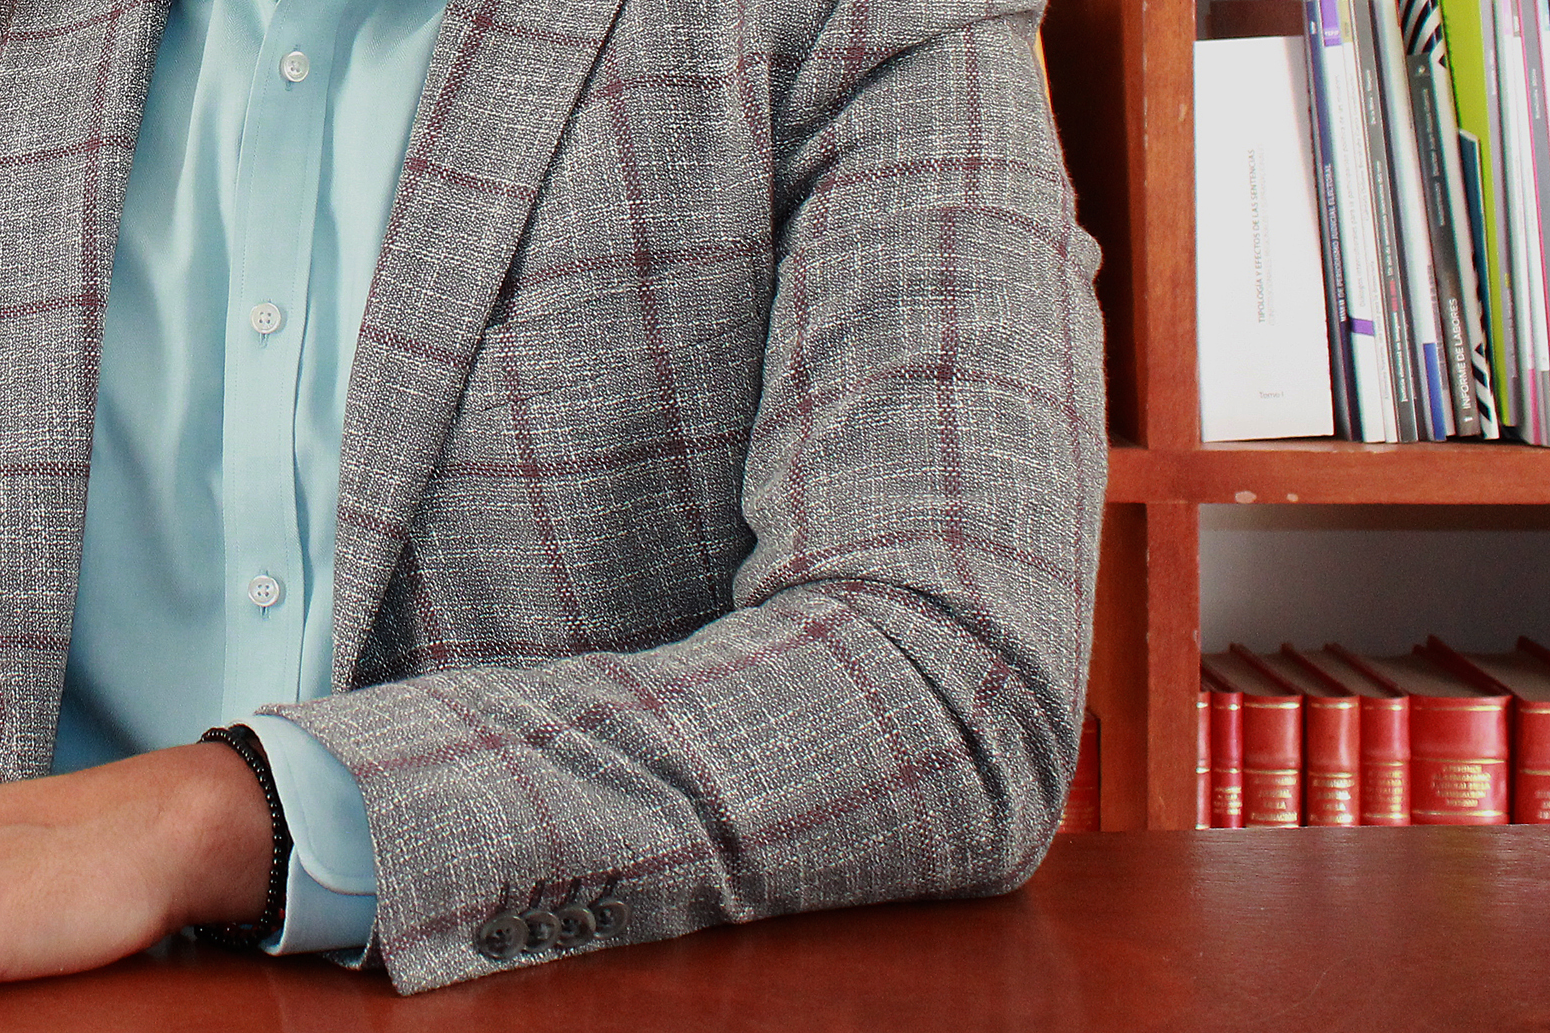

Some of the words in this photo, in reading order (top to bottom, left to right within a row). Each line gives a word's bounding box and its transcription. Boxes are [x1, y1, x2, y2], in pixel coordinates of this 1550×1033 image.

[1249, 149, 1258, 200] SENTENCIAS
[1324, 162, 1335, 205] ELECTORAL
[1253, 219, 1259, 231] DE
[1328, 205, 1338, 240] JUDICIAL
[1254, 232, 1262, 269] EFECTOS
[1332, 240, 1343, 286] PERIODISMO
[1449, 298, 1461, 346] LABORES
[1454, 346, 1465, 361] DE
[1458, 362, 1471, 409] INFORME
